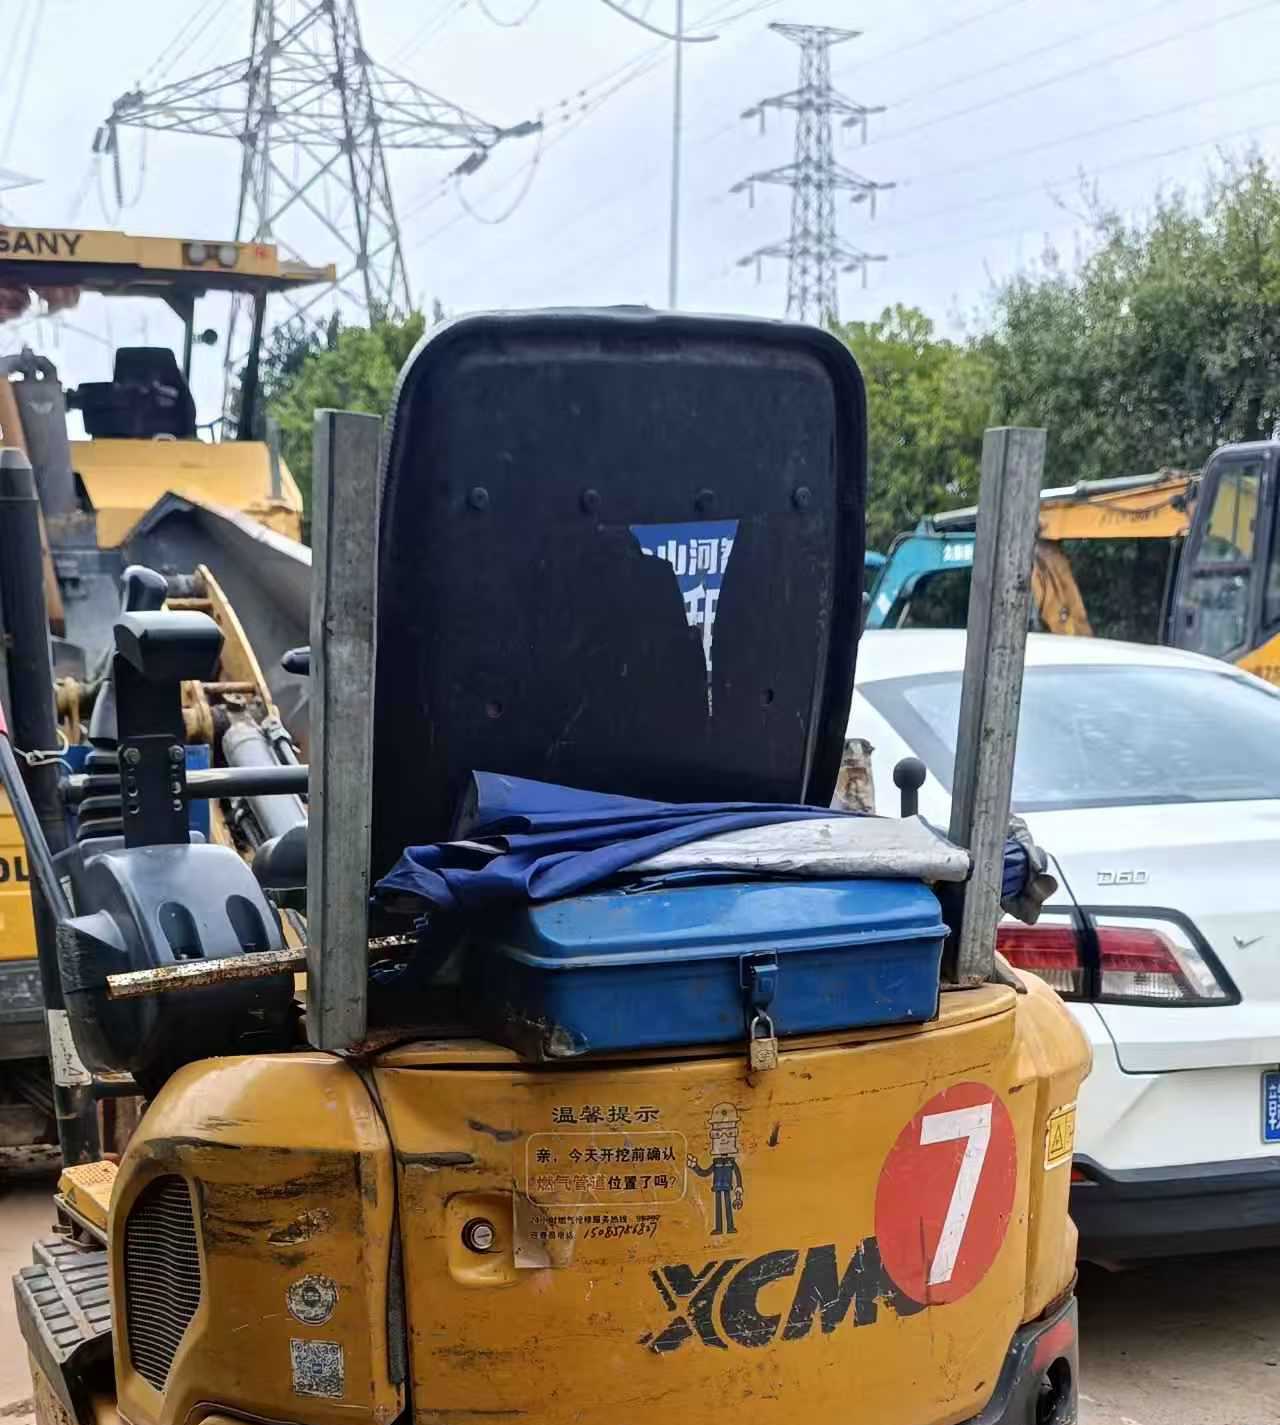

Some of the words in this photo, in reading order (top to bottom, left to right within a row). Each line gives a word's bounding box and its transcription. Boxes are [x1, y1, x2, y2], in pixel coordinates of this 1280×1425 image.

[0, 230, 81, 256] SANY
[1096, 871, 1150, 886] D60
[552, 1105, 660, 1124] 温馨提示
[536, 1147, 676, 1164] 亲，今天开挖前确认
[920, 1103, 992, 1285] 7
[640, 1236, 928, 1354] XCM
